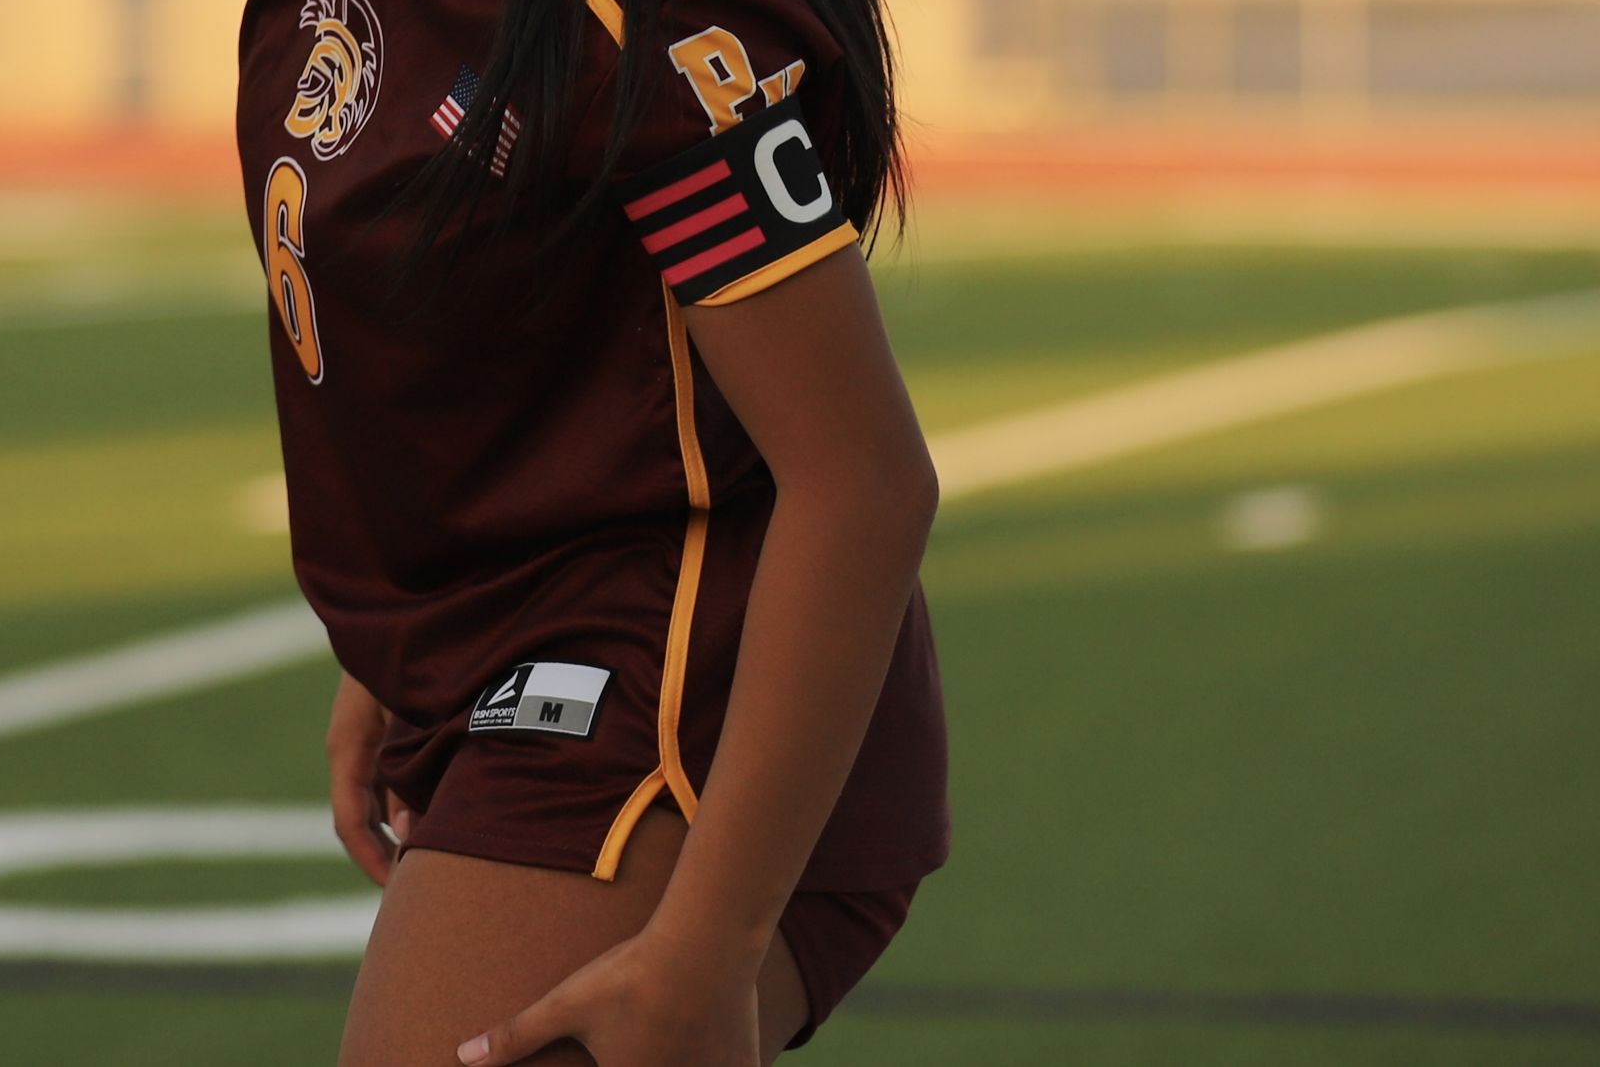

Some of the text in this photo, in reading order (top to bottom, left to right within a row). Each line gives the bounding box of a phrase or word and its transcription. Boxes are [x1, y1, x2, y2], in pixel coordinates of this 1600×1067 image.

[754, 118, 833, 223] C
[263, 156, 324, 385] 6
[489, 707, 516, 718] SPORTS
[539, 702, 563, 723] M
